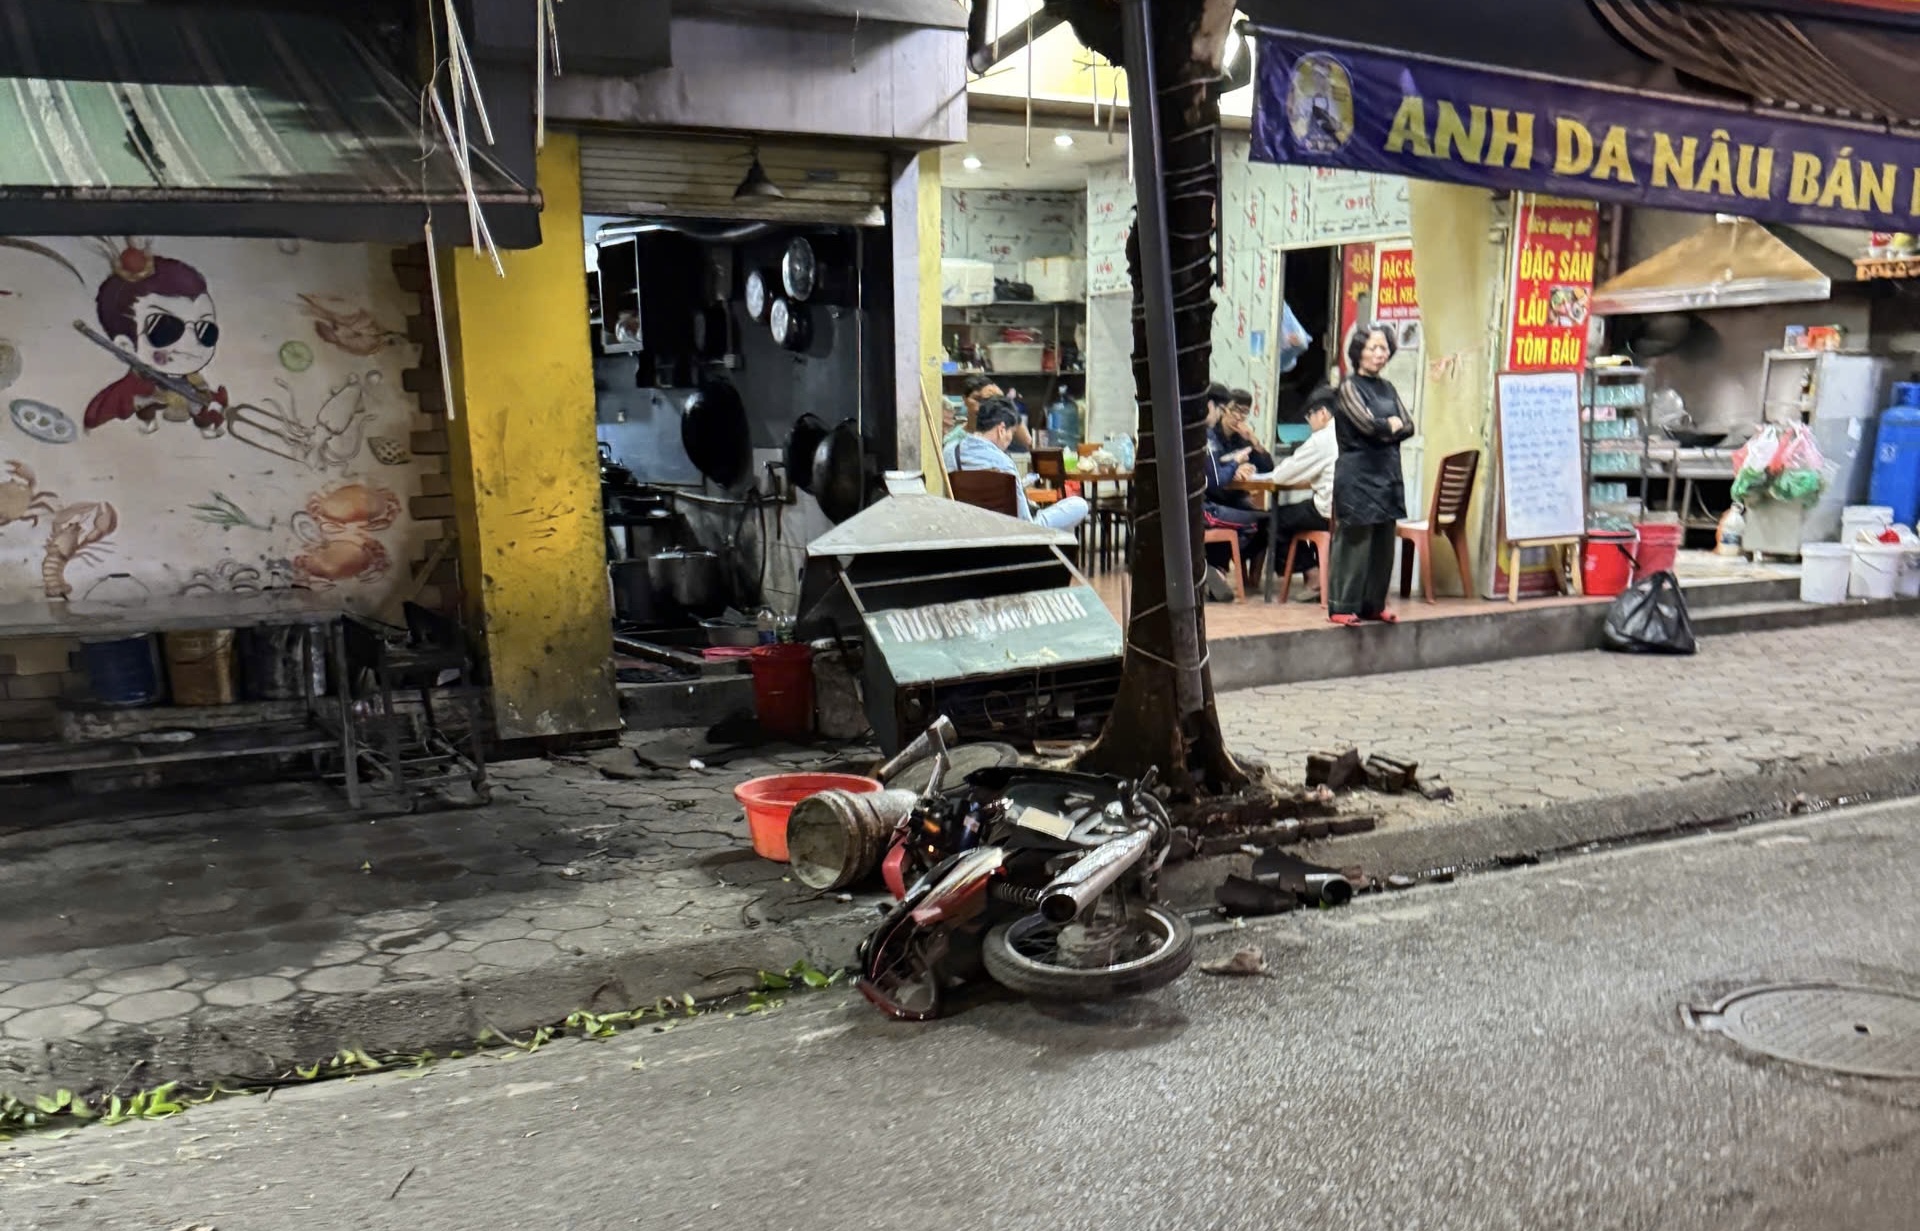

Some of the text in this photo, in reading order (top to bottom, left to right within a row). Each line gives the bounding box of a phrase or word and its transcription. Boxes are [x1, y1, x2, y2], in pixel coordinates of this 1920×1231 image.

[1384, 96, 1535, 170] ANH
[1554, 117, 1636, 183] DA
[1651, 128, 1774, 201] NÂU
[1787, 146, 1898, 215] BÁN
[1519, 240, 1595, 286] ĐẶC SẢN
[1518, 287, 1548, 327] LẨU
[1516, 332, 1548, 365] TÔM
